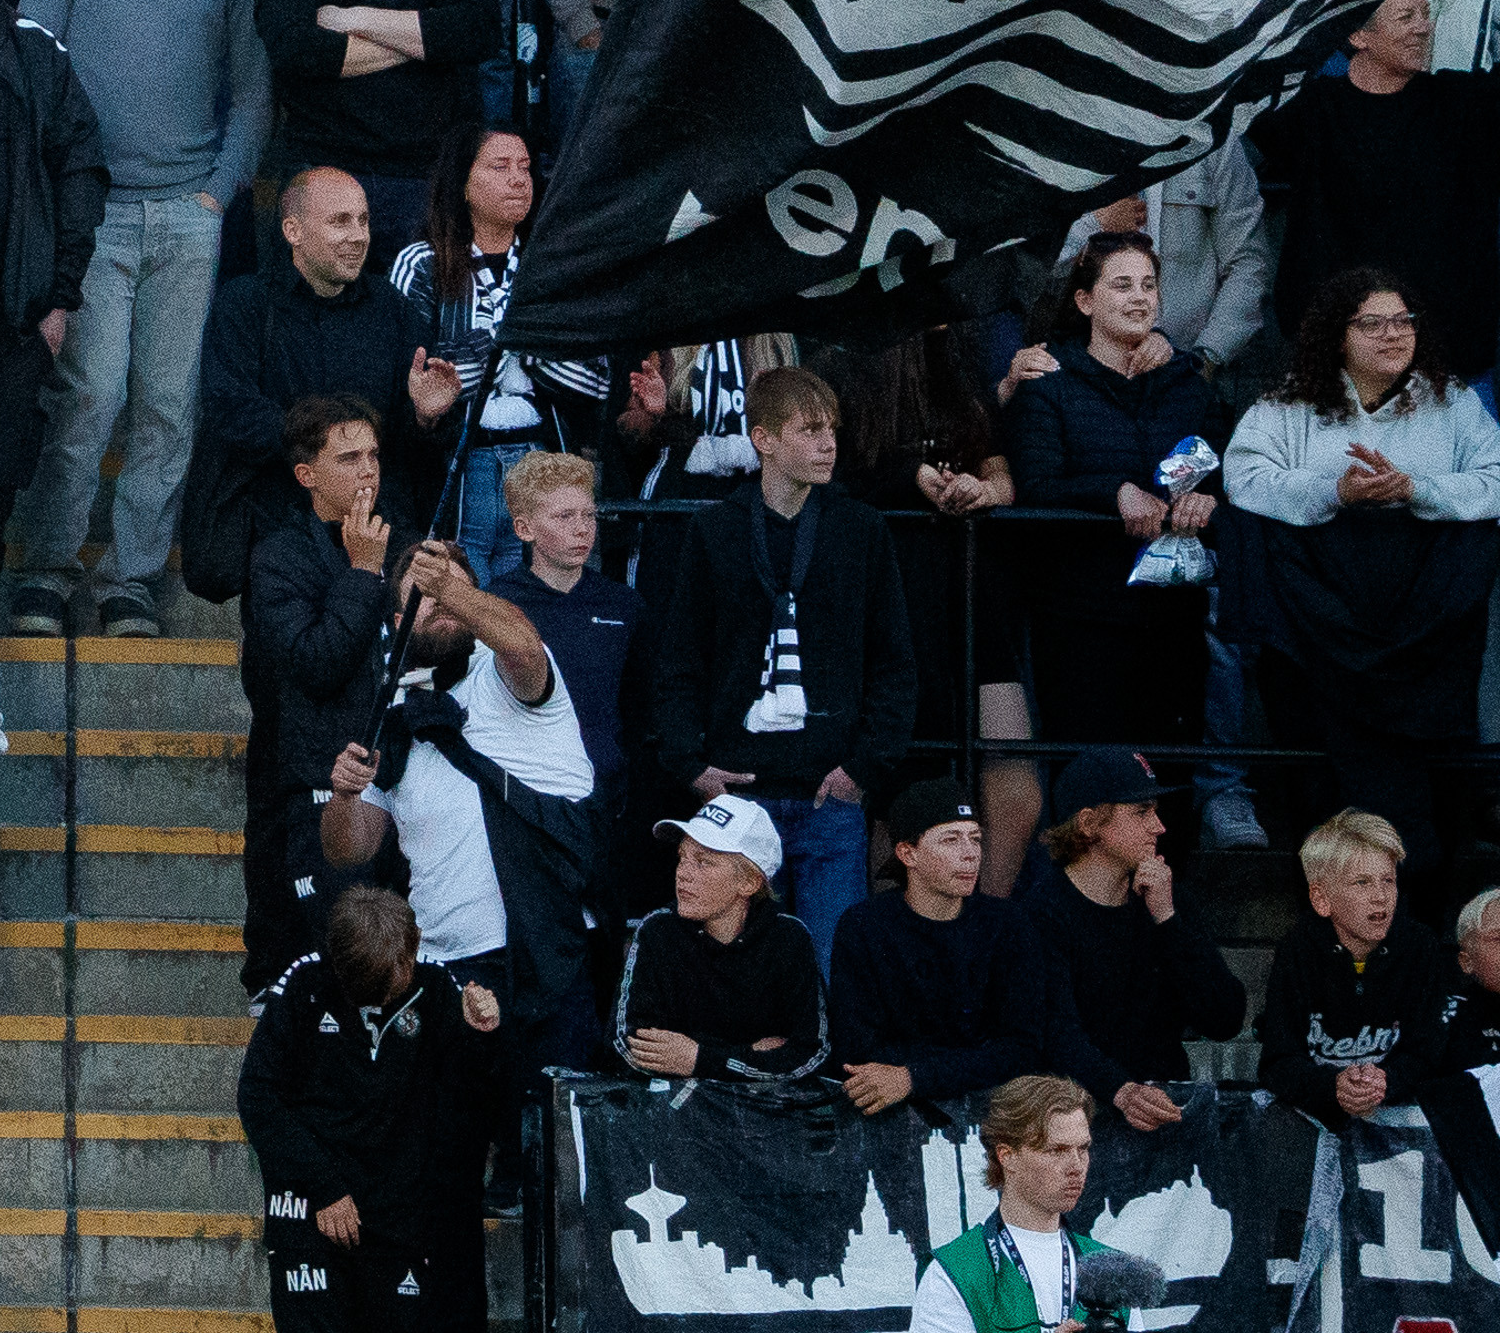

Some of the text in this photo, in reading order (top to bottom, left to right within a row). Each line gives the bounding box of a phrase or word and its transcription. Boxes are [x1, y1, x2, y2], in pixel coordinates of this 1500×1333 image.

[294, 875, 316, 899] NK
[269, 1190, 308, 1220] NÅN
[286, 1262, 328, 1292] NÅN
